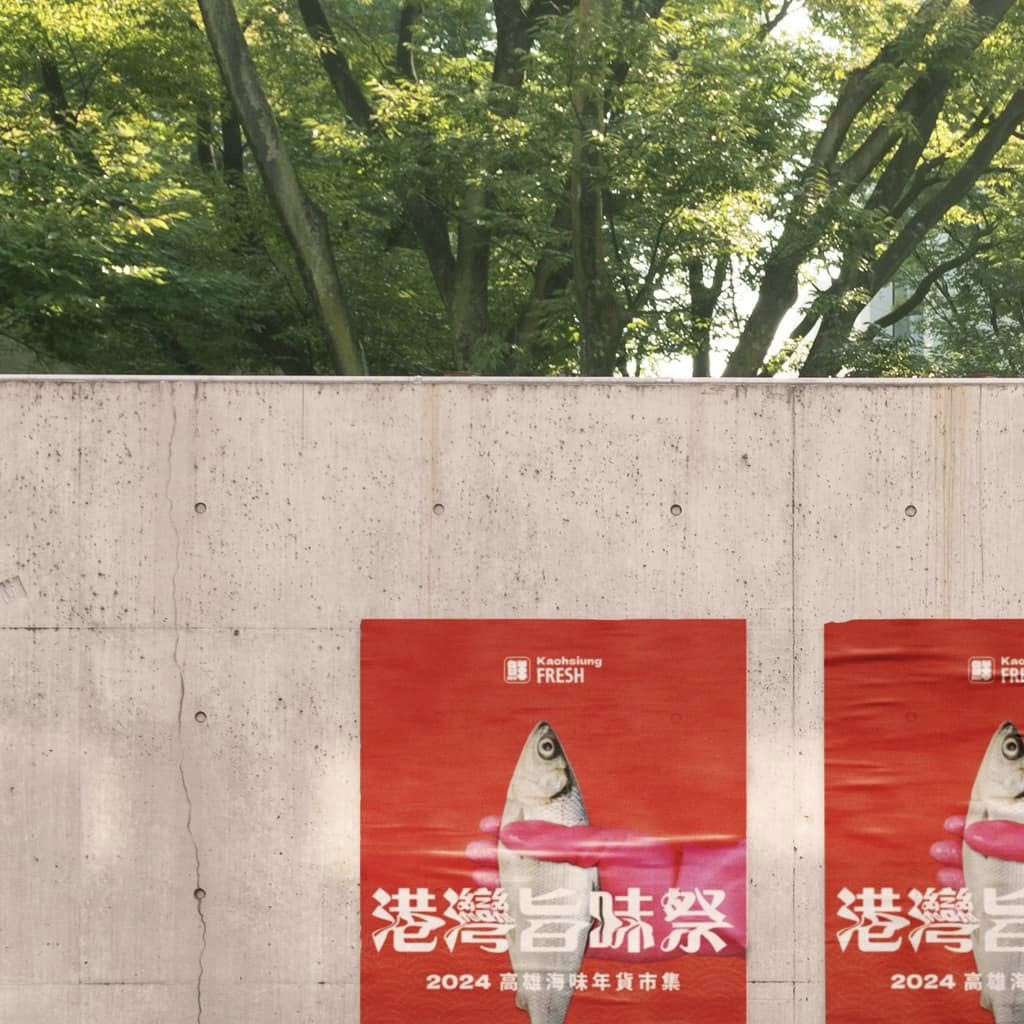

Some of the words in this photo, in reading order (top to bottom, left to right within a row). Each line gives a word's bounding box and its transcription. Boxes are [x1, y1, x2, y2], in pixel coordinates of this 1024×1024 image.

[536, 655, 603, 668] Kaohsiung
[536, 667, 585, 684] FRESH
[371, 887, 737, 953] 港灣旨味祭
[426, 974, 492, 990] 2024
[499, 971, 682, 992] 高雄海味年貨市集
[890, 974, 956, 990] 2024
